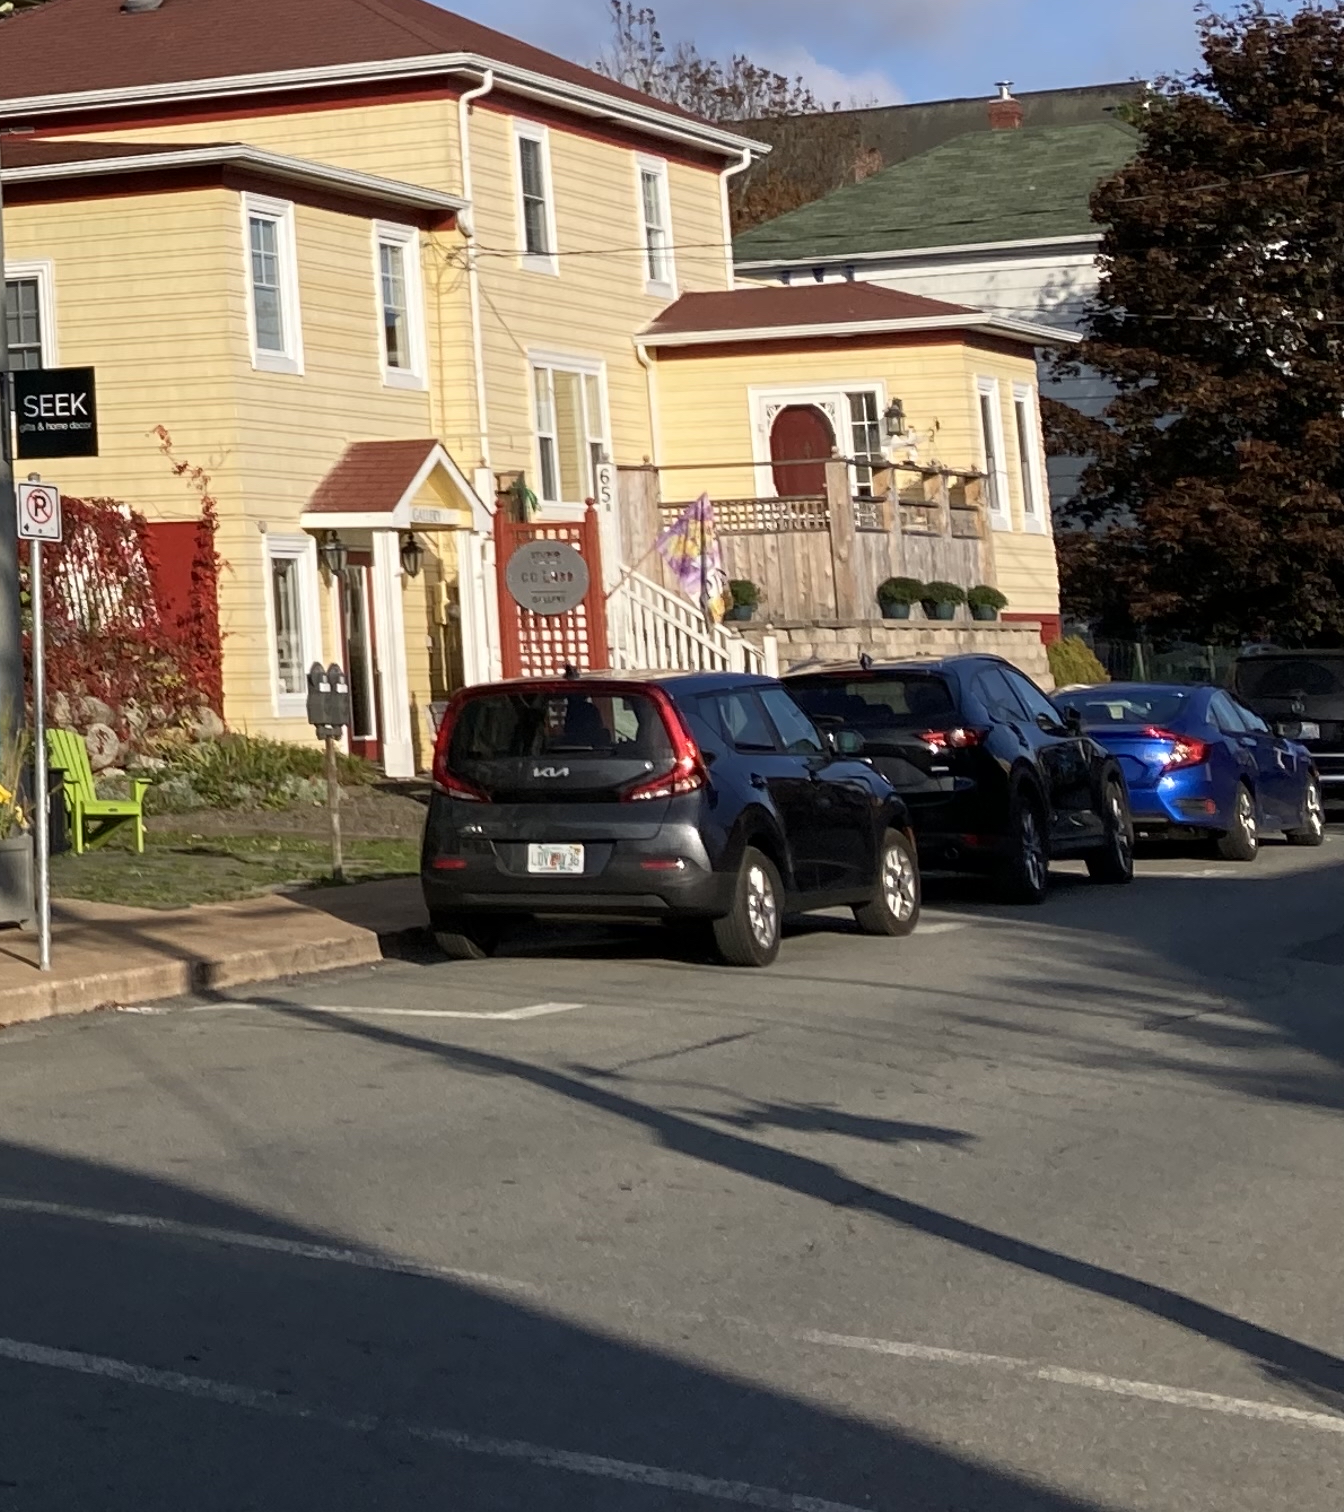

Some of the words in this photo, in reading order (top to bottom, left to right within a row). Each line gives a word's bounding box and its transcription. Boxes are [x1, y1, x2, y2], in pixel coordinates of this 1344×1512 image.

[23, 392, 88, 418] SEEK
[37, 422, 44, 431] &
[45, 422, 68, 431] home
[69, 421, 92, 430] decor
[533, 767, 570, 778] KIA
